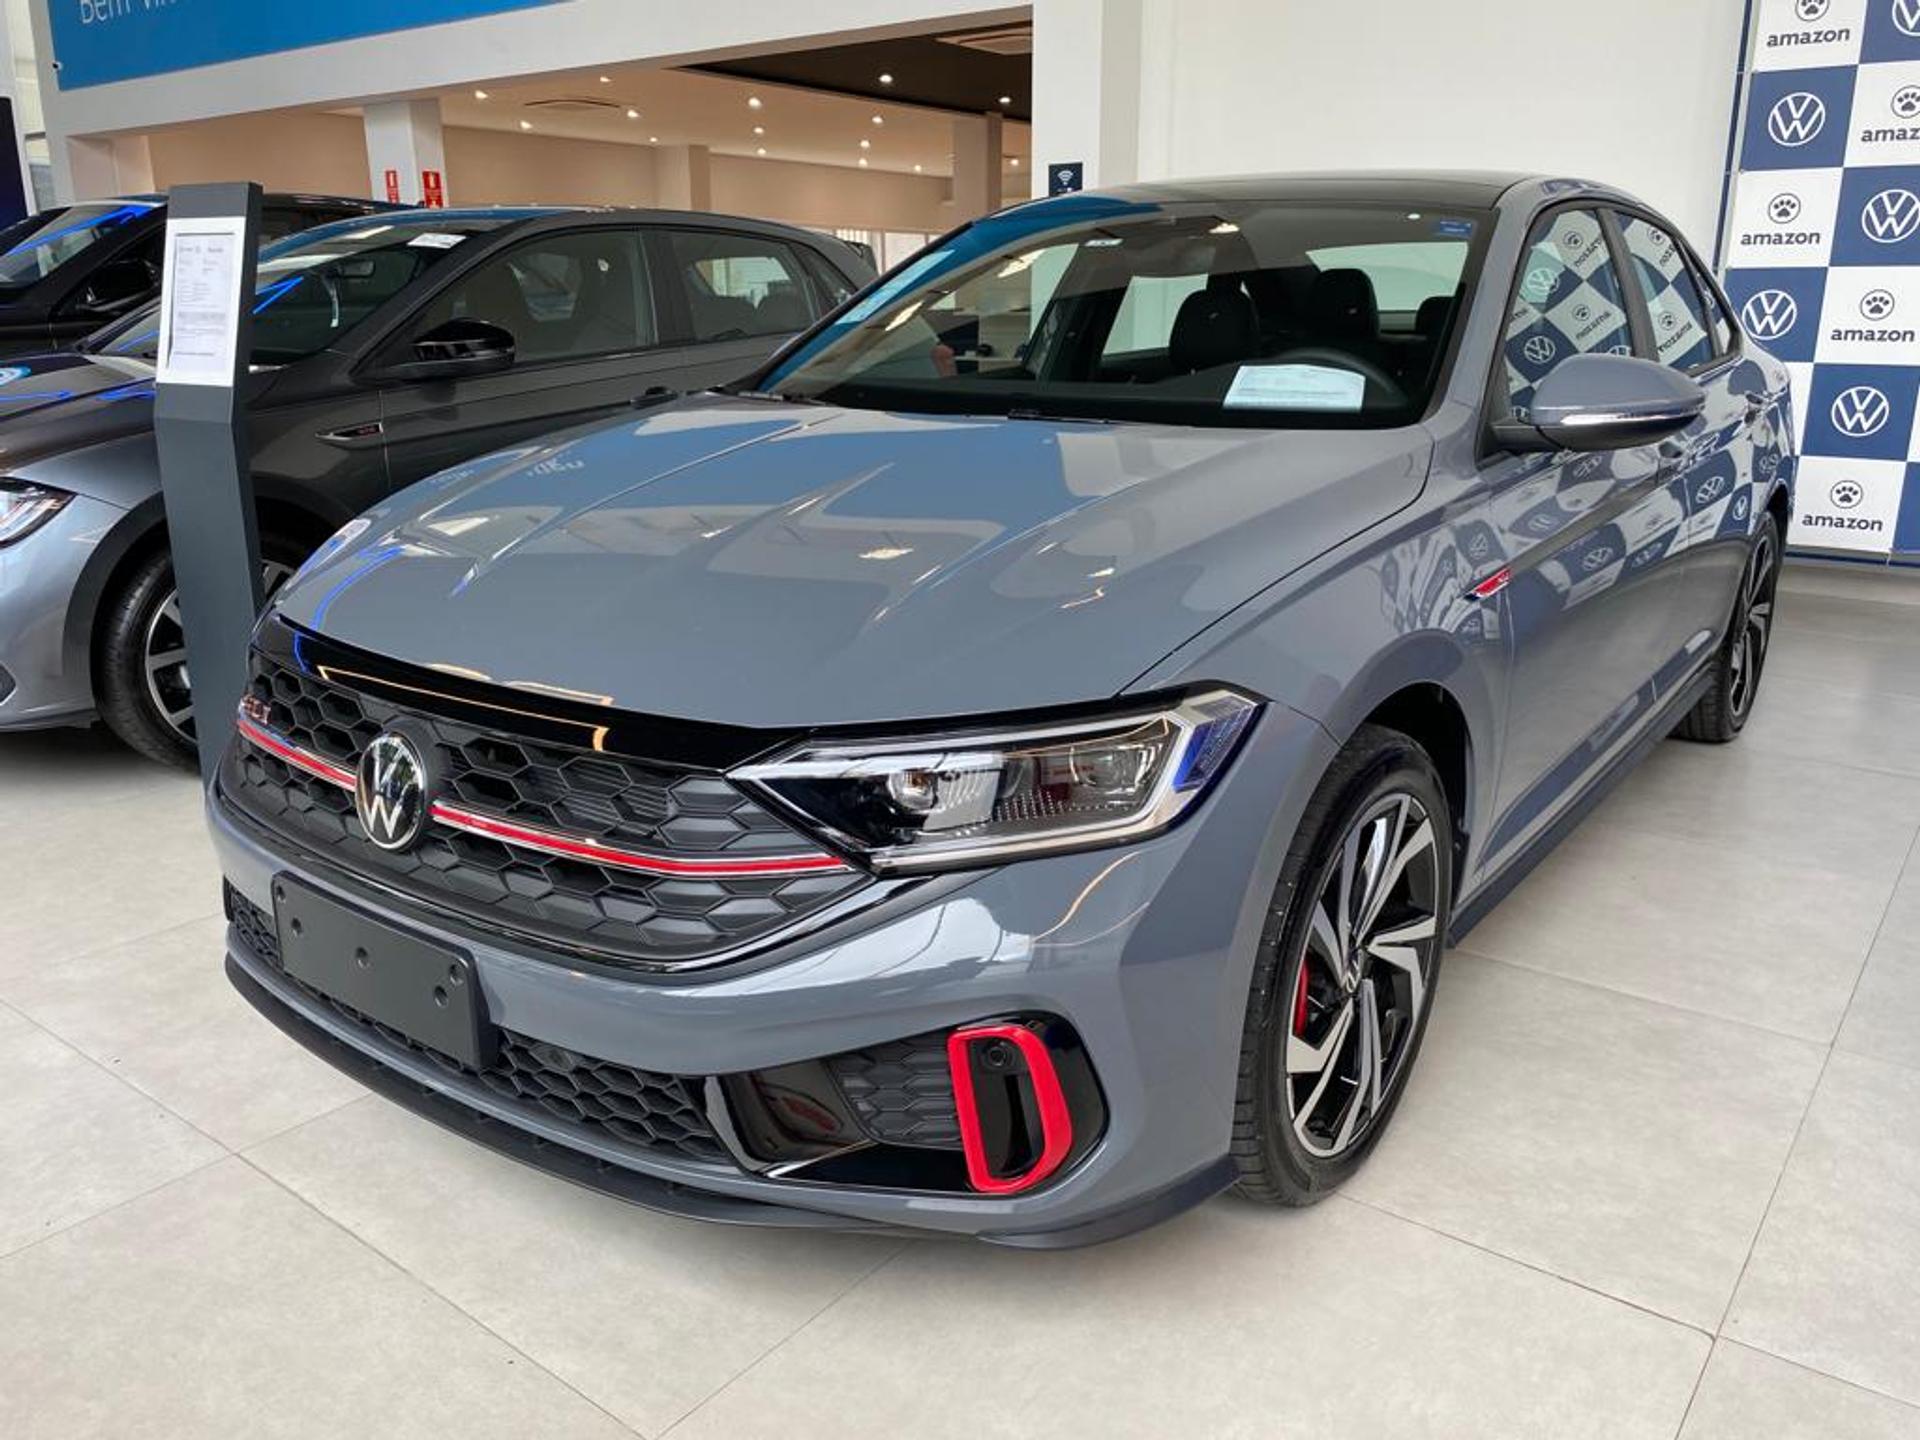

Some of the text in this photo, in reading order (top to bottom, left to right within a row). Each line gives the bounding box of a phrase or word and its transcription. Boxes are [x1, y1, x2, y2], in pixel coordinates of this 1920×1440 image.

[1766, 28, 1850, 47] amazon
[1768, 92, 1826, 146] VW
[1861, 128, 1920, 142] amaz
[1862, 189, 1920, 243] VW
[1740, 231, 1821, 245] amazon
[1742, 289, 1798, 340] VW
[1831, 326, 1916, 343] amazon
[1831, 386, 1890, 437] VW
[1801, 512, 1884, 532] amazon
